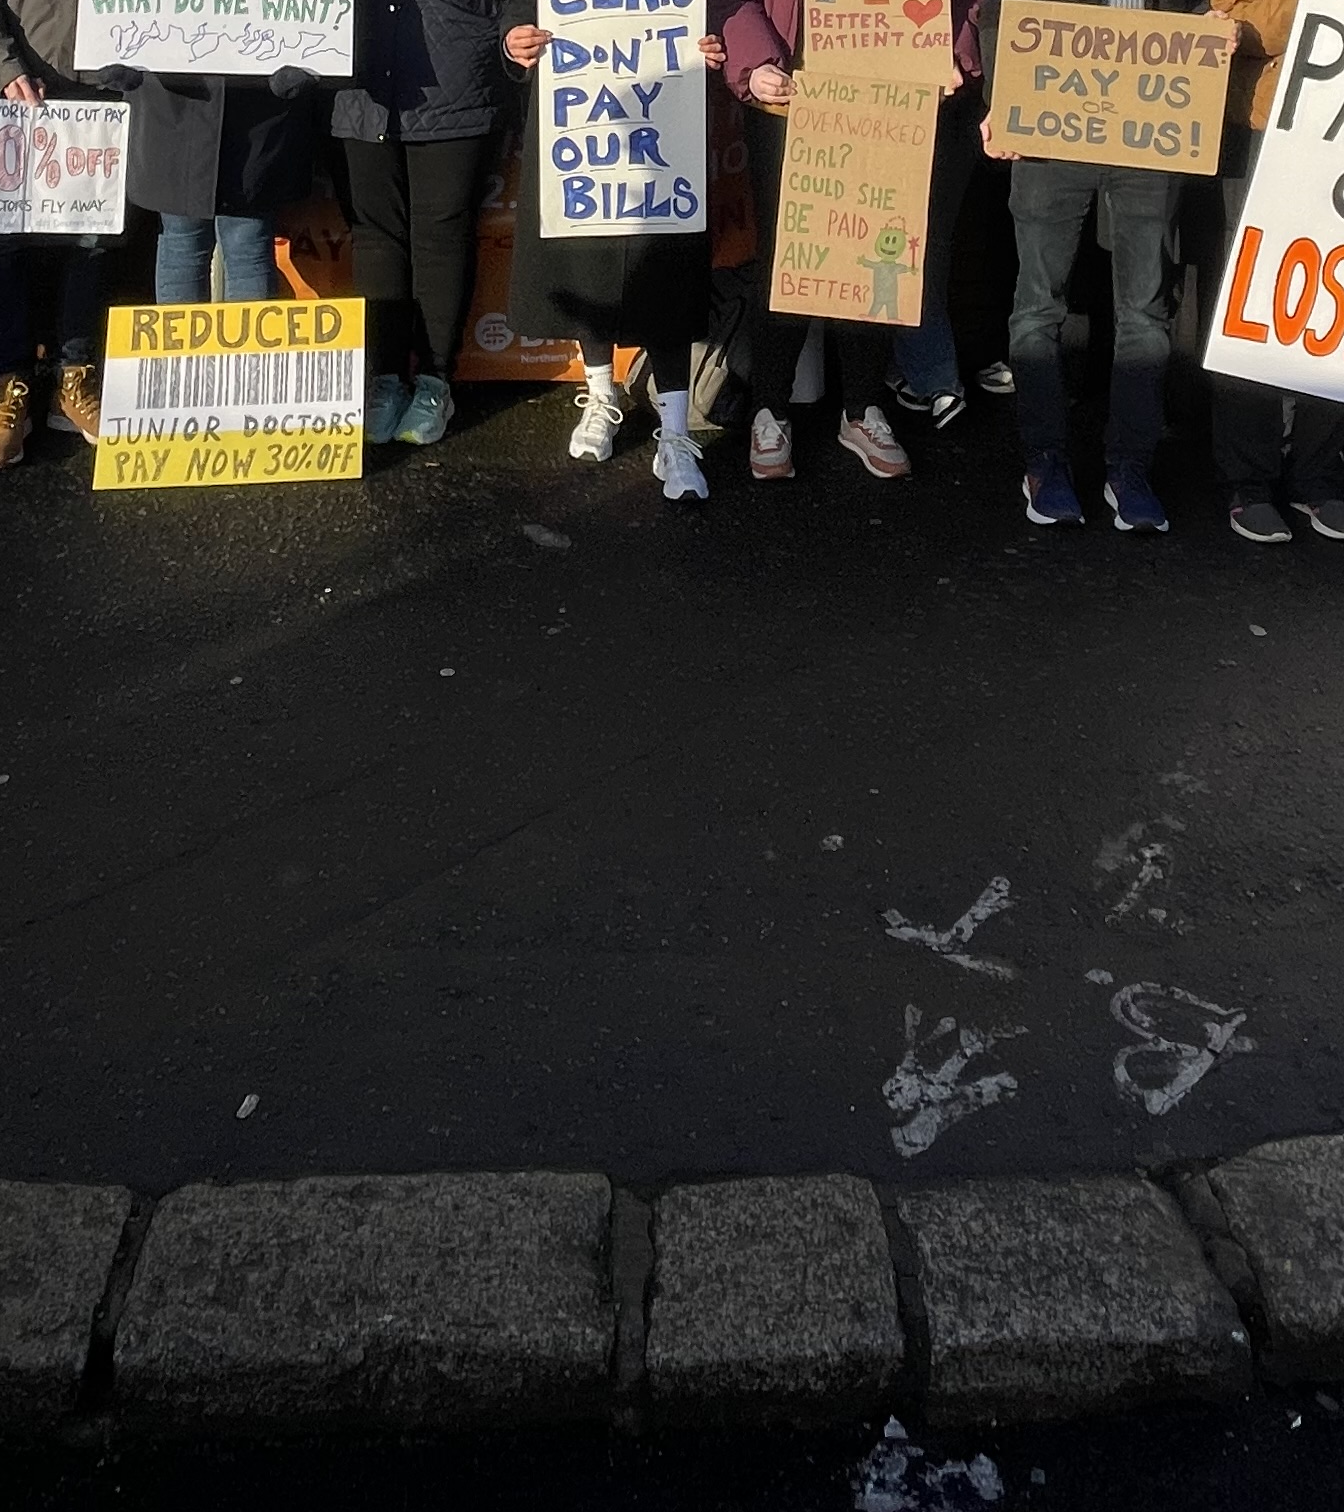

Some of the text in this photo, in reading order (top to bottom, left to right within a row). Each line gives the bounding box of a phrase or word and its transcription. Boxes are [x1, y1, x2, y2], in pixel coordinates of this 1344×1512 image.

[809, 7, 891, 30] BETTER
[551, 25, 689, 75] DON'T
[812, 31, 950, 51] PATIENT CARE
[870, 83, 931, 111] THAT
[1034, 64, 1191, 109] PAY US
[38, 105, 71, 120] AND
[75, 107, 100, 122] CUT
[104, 107, 127, 123] PAY
[553, 82, 663, 128] PAY
[1082, 101, 1119, 114] OR
[793, 106, 926, 146] OVERWORKED
[1006, 105, 1201, 158] LOSE US!
[66, 146, 121, 179] OFF
[551, 127, 671, 172] OUR
[789, 136, 853, 169] GIRL?
[41, 199, 66, 214] FLY
[562, 175, 699, 220] BILLS
[788, 172, 897, 211] COULD SHE
[783, 200, 869, 240] BE PAID
[779, 241, 830, 270] ANY
[780, 272, 870, 303] BETTER?
[131, 304, 343, 351] REDUCED
[106, 415, 221, 446] JUNIOR
[114, 441, 358, 484] PAY NOW 30% OFF
